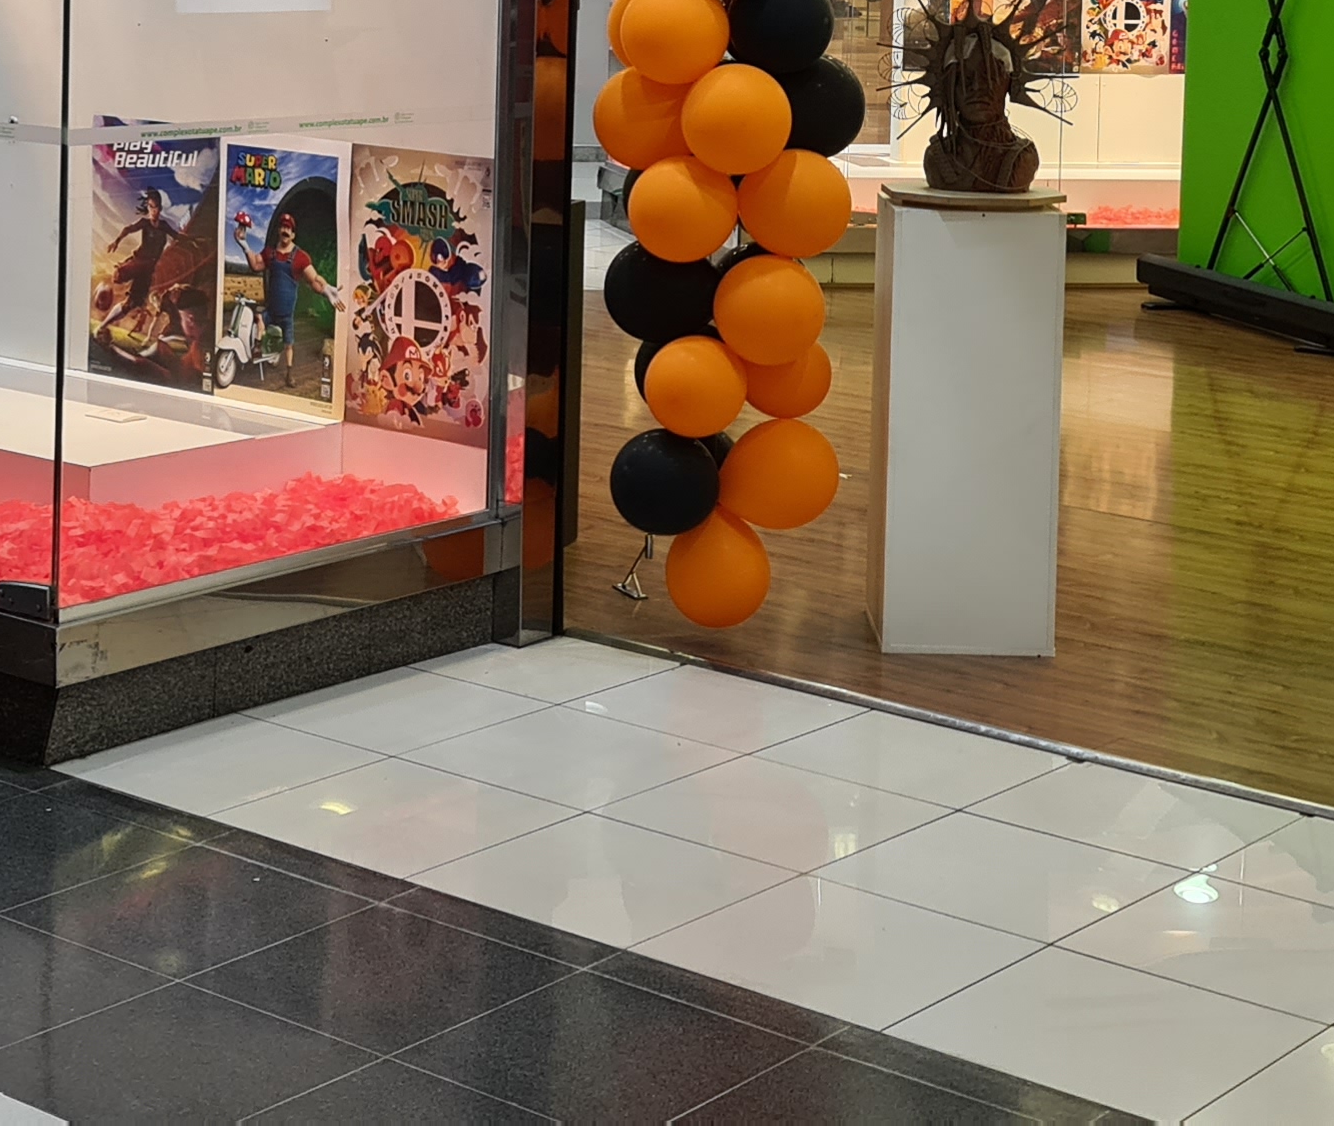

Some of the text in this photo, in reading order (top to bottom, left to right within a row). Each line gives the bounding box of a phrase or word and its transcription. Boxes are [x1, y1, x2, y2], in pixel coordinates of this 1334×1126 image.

[114, 150, 199, 169] Beautiful
[237, 151, 278, 169] SUPER
[230, 167, 282, 191] MARIO
[389, 199, 449, 230] SMASH
